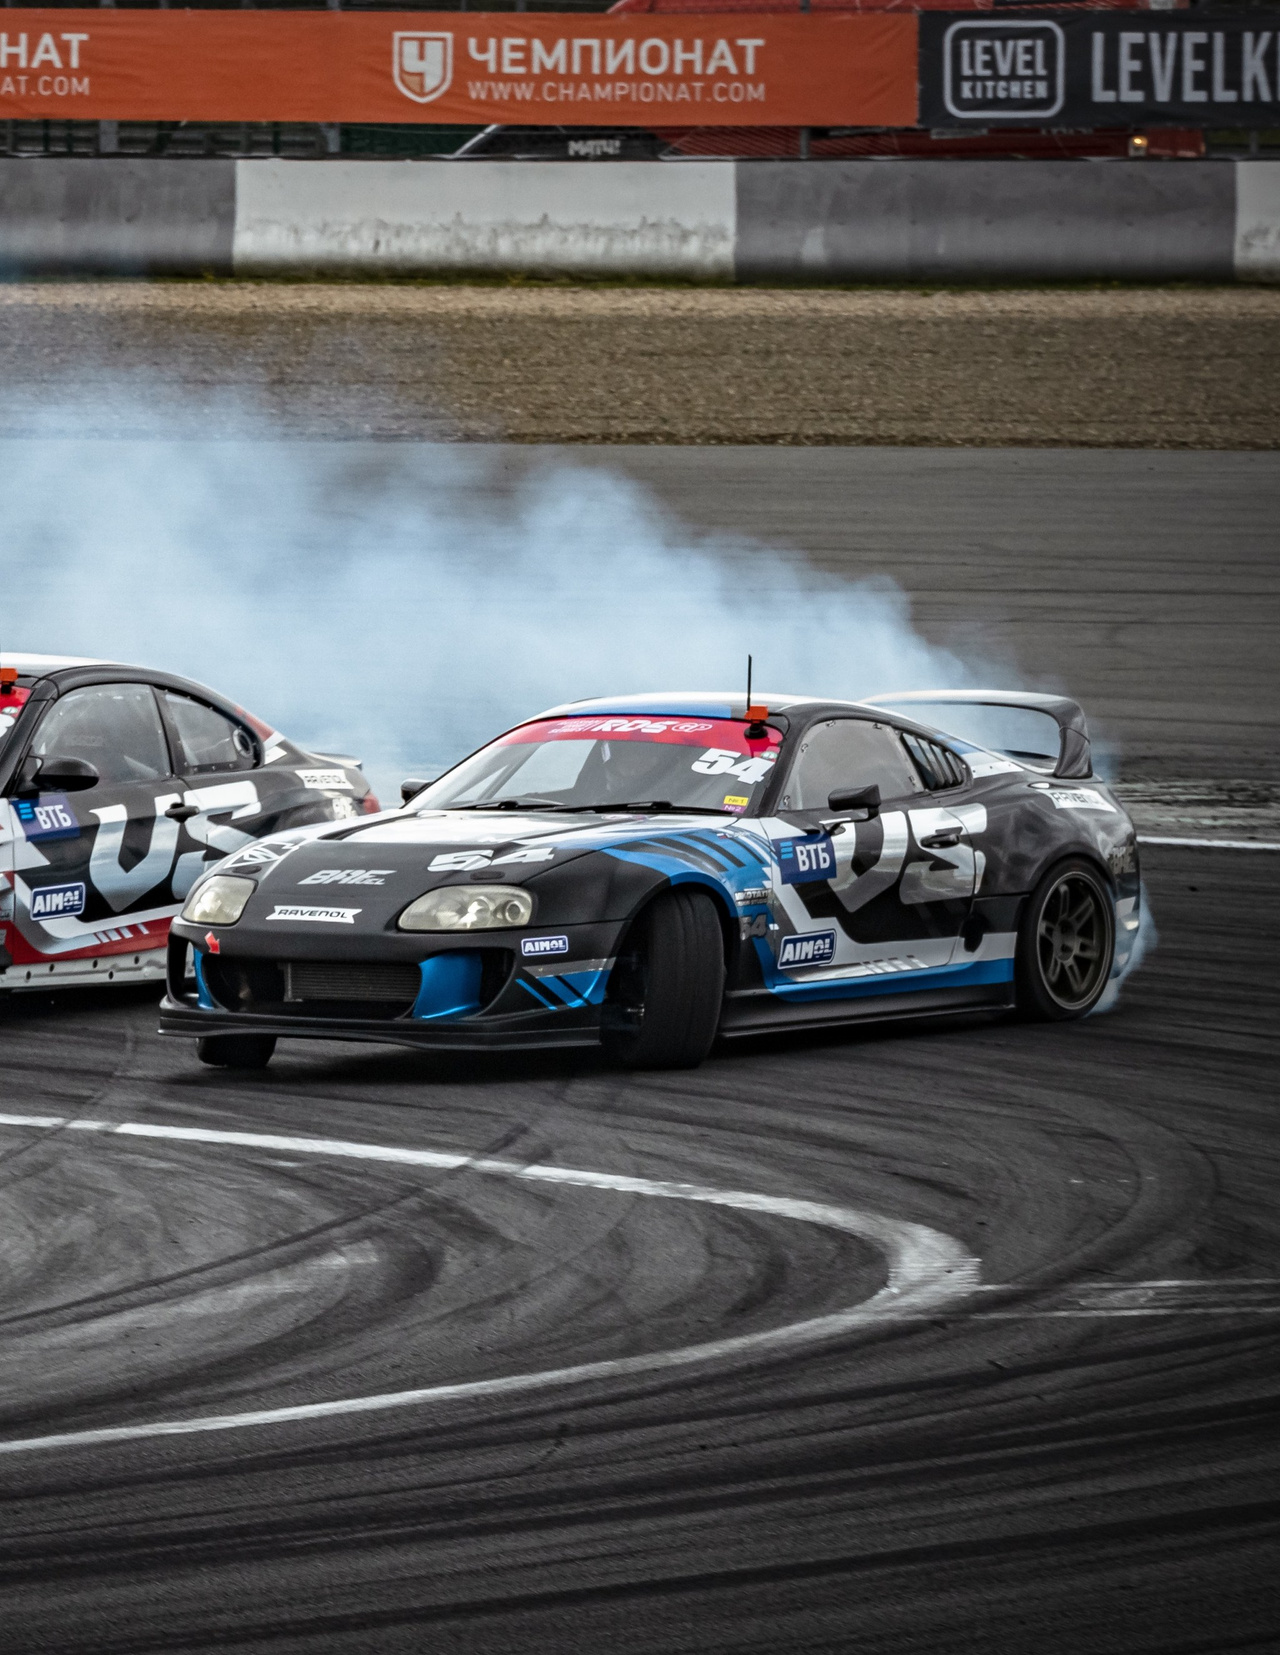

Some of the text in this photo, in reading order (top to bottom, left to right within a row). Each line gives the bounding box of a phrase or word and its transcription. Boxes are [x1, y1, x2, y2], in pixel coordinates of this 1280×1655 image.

[468, 37, 766, 75] ЧЕМПИОНАТ
[960, 39, 1048, 76] LEVEL
[1091, 32, 1280, 103] LEVELK
[467, 81, 766, 102] WWW.CHAMPIONAT.COM
[960, 80, 1049, 99] KITCHEN
[593, 718, 681, 734] RDS
[691, 747, 776, 785] 54
[37, 803, 73, 830] ВТБ
[427, 847, 555, 872] 54
[795, 841, 831, 873] ВТБ
[32, 889, 82, 914] AIMOL
[277, 908, 349, 919] RAVENOL
[524, 938, 567, 953] AIMOL
[780, 937, 833, 963] AIMOL
